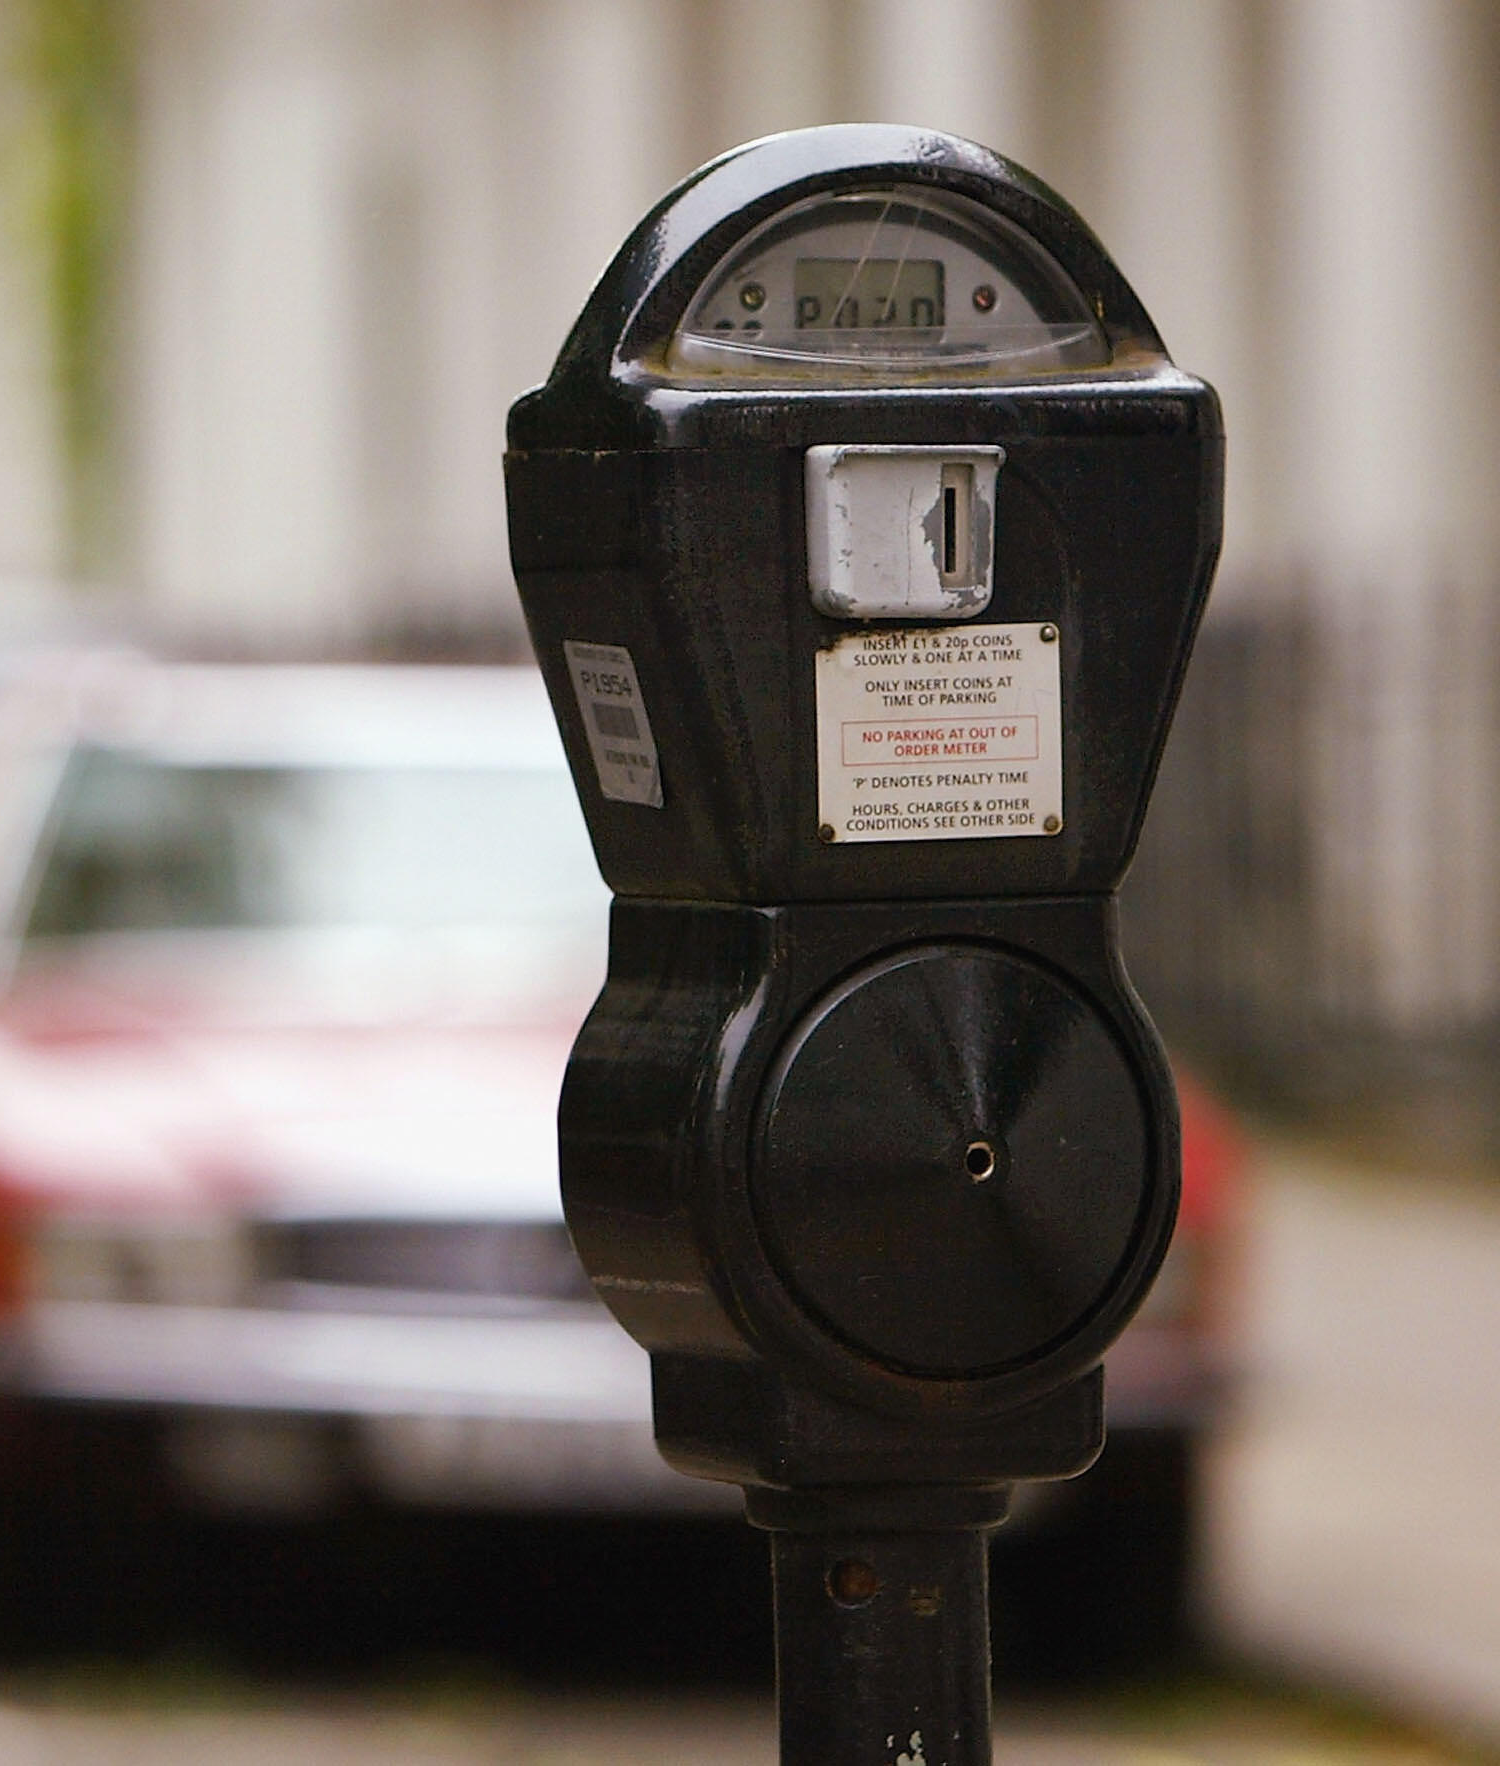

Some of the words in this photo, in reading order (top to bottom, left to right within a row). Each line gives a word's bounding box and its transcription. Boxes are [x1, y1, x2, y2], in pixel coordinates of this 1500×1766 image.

[863, 635, 908, 650] INSERT
[913, 637, 926, 649] £1
[932, 638, 940, 648] &
[946, 636, 969, 650] 20p
[972, 635, 1012, 647] COINS
[854, 653, 907, 666] SLOWLY
[912, 653, 920, 664] &
[925, 652, 952, 664] ONE
[958, 650, 973, 662] AT
[978, 651, 987, 662] A
[992, 649, 1022, 660] TIME
[865, 680, 899, 693] ONLY
[904, 678, 947, 691] INSERT
[953, 677, 992, 689] COINS
[996, 676, 1013, 687] AT
[882, 695, 913, 706] TIME
[919, 694, 934, 705] OF
[940, 692, 996, 705] PARKING
[862, 731, 882, 743] NO
[887, 729, 944, 741] PARKING
[949, 728, 965, 739] AT
[969, 727, 996, 738] OUT
[1001, 726, 1017, 737] OF
[894, 745, 939, 757] ORDER
[944, 743, 987, 755] METER
[872, 776, 932, 789] DENOTES
[937, 773, 992, 785] PENALTY
[999, 772, 1029, 783] TIME
[908, 801, 968, 813] CHARGES
[974, 801, 982, 811] &
[986, 799, 1029, 811] OTHER
[847, 818, 929, 831] CONDITIONS
[934, 816, 955, 828] SEE
[960, 814, 1003, 827] OTHER
[1008, 813, 1035, 825] SIDE
